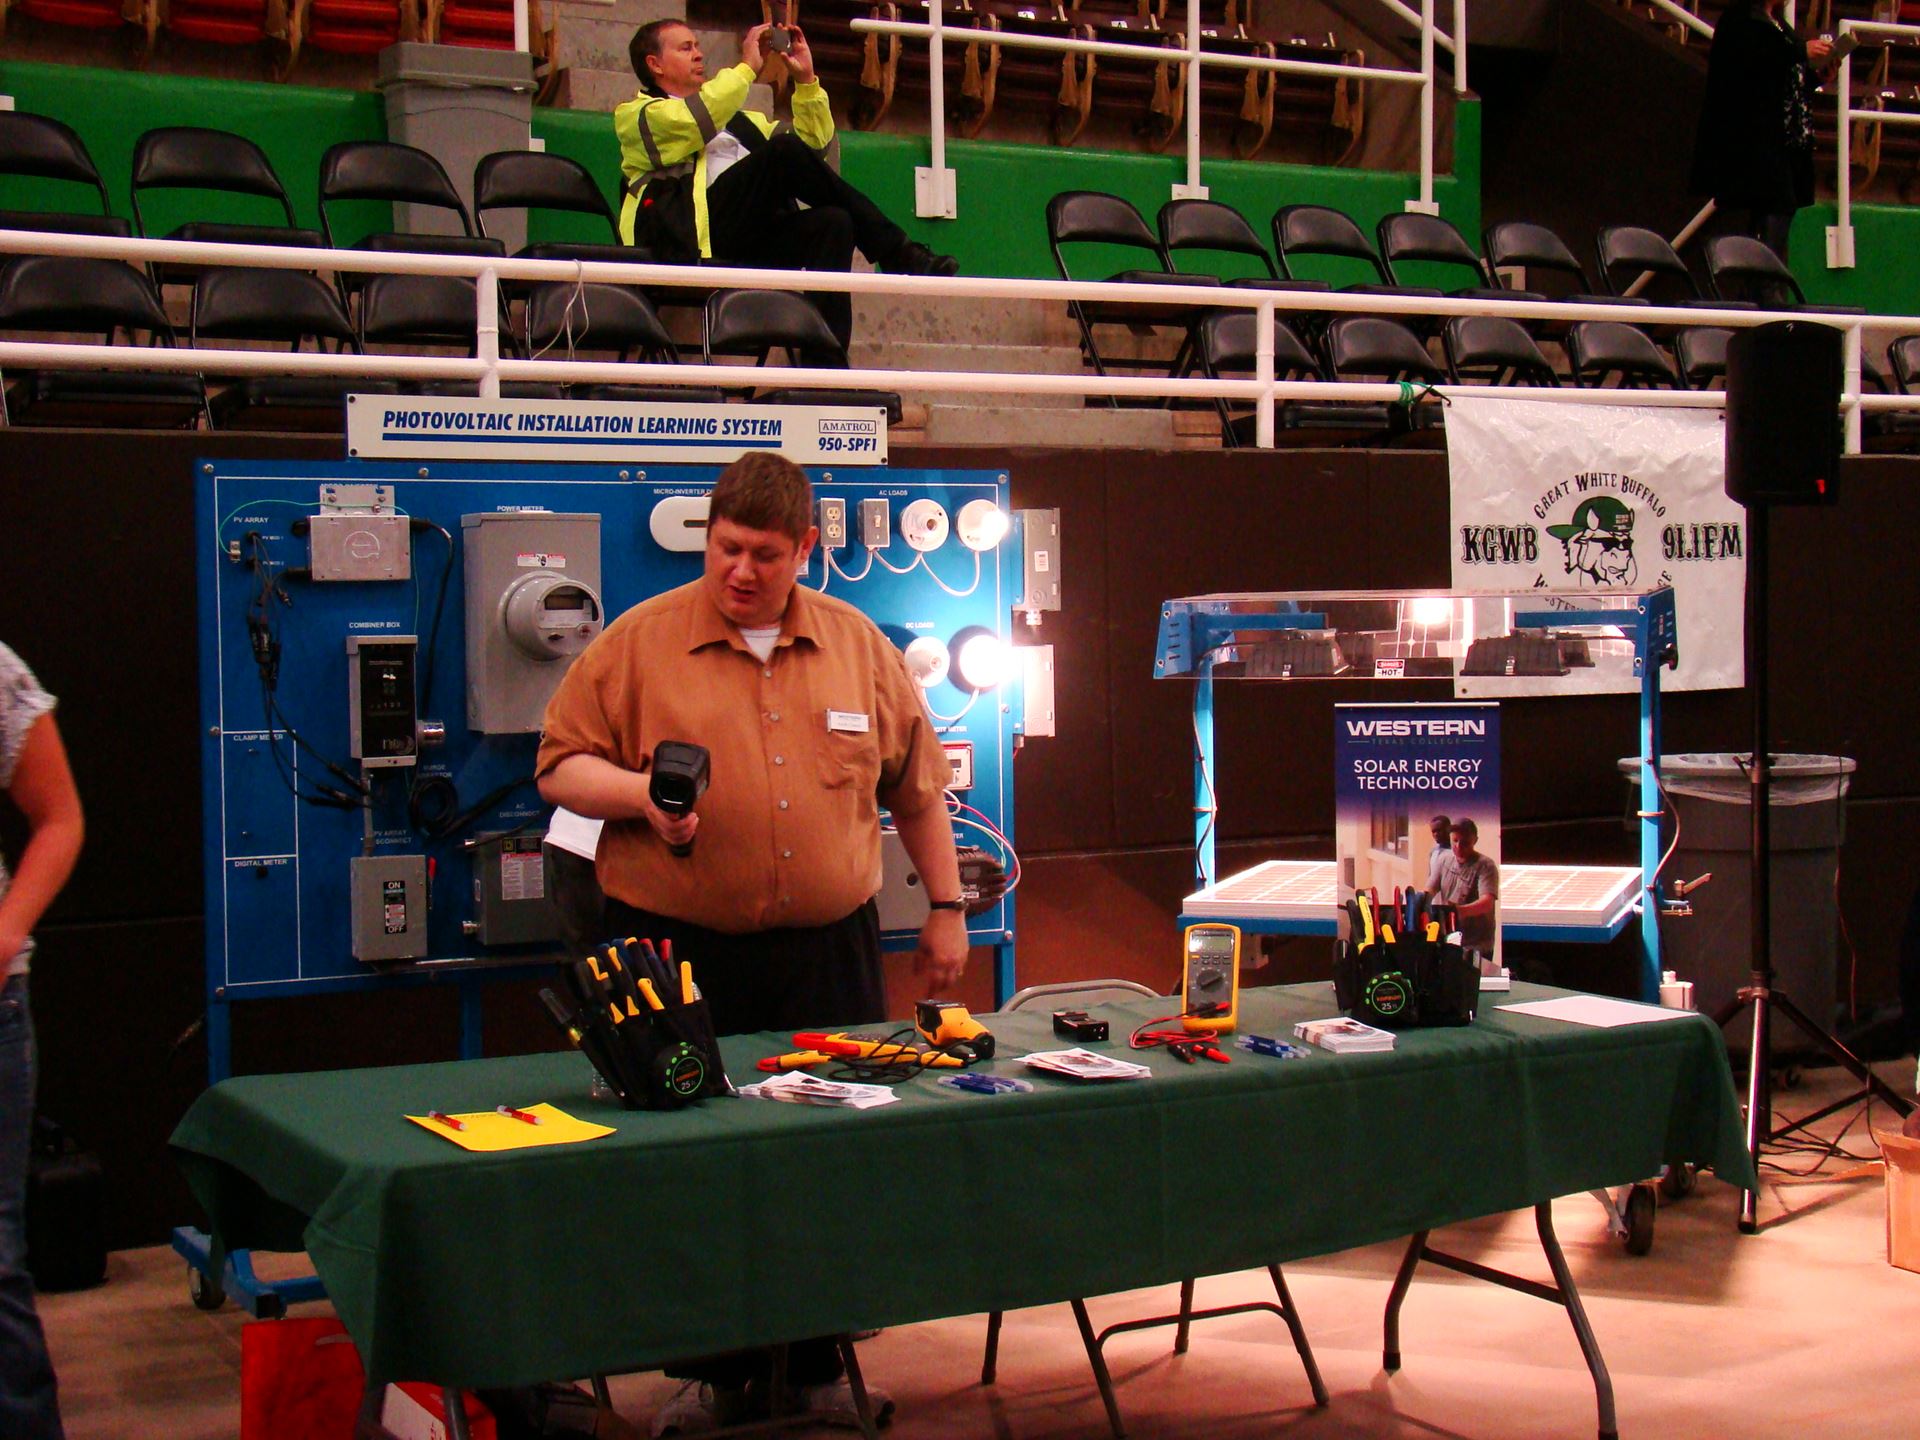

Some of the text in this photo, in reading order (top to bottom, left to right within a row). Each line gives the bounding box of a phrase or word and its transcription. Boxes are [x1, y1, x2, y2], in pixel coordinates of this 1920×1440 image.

[383, 410, 782, 436] PHOTOVOLTAIC INSTALLATION LEARNING SYSTEM
[822, 422, 873, 431] AMATROL
[818, 437, 877, 451] 950-SPF1
[1533, 472, 1666, 519] GREAT WHITE BUFFALO
[1461, 525, 1538, 563] KGWB
[348, 621, 385, 629] COMBINER
[1346, 720, 1485, 736] WESTERN
[1411, 737, 1460, 745] COLLEGE
[1354, 759, 1482, 773] SOLAR ENERGY
[1357, 775, 1479, 790] TECHNOLOGY
[234, 859, 262, 867] DIGITAL
